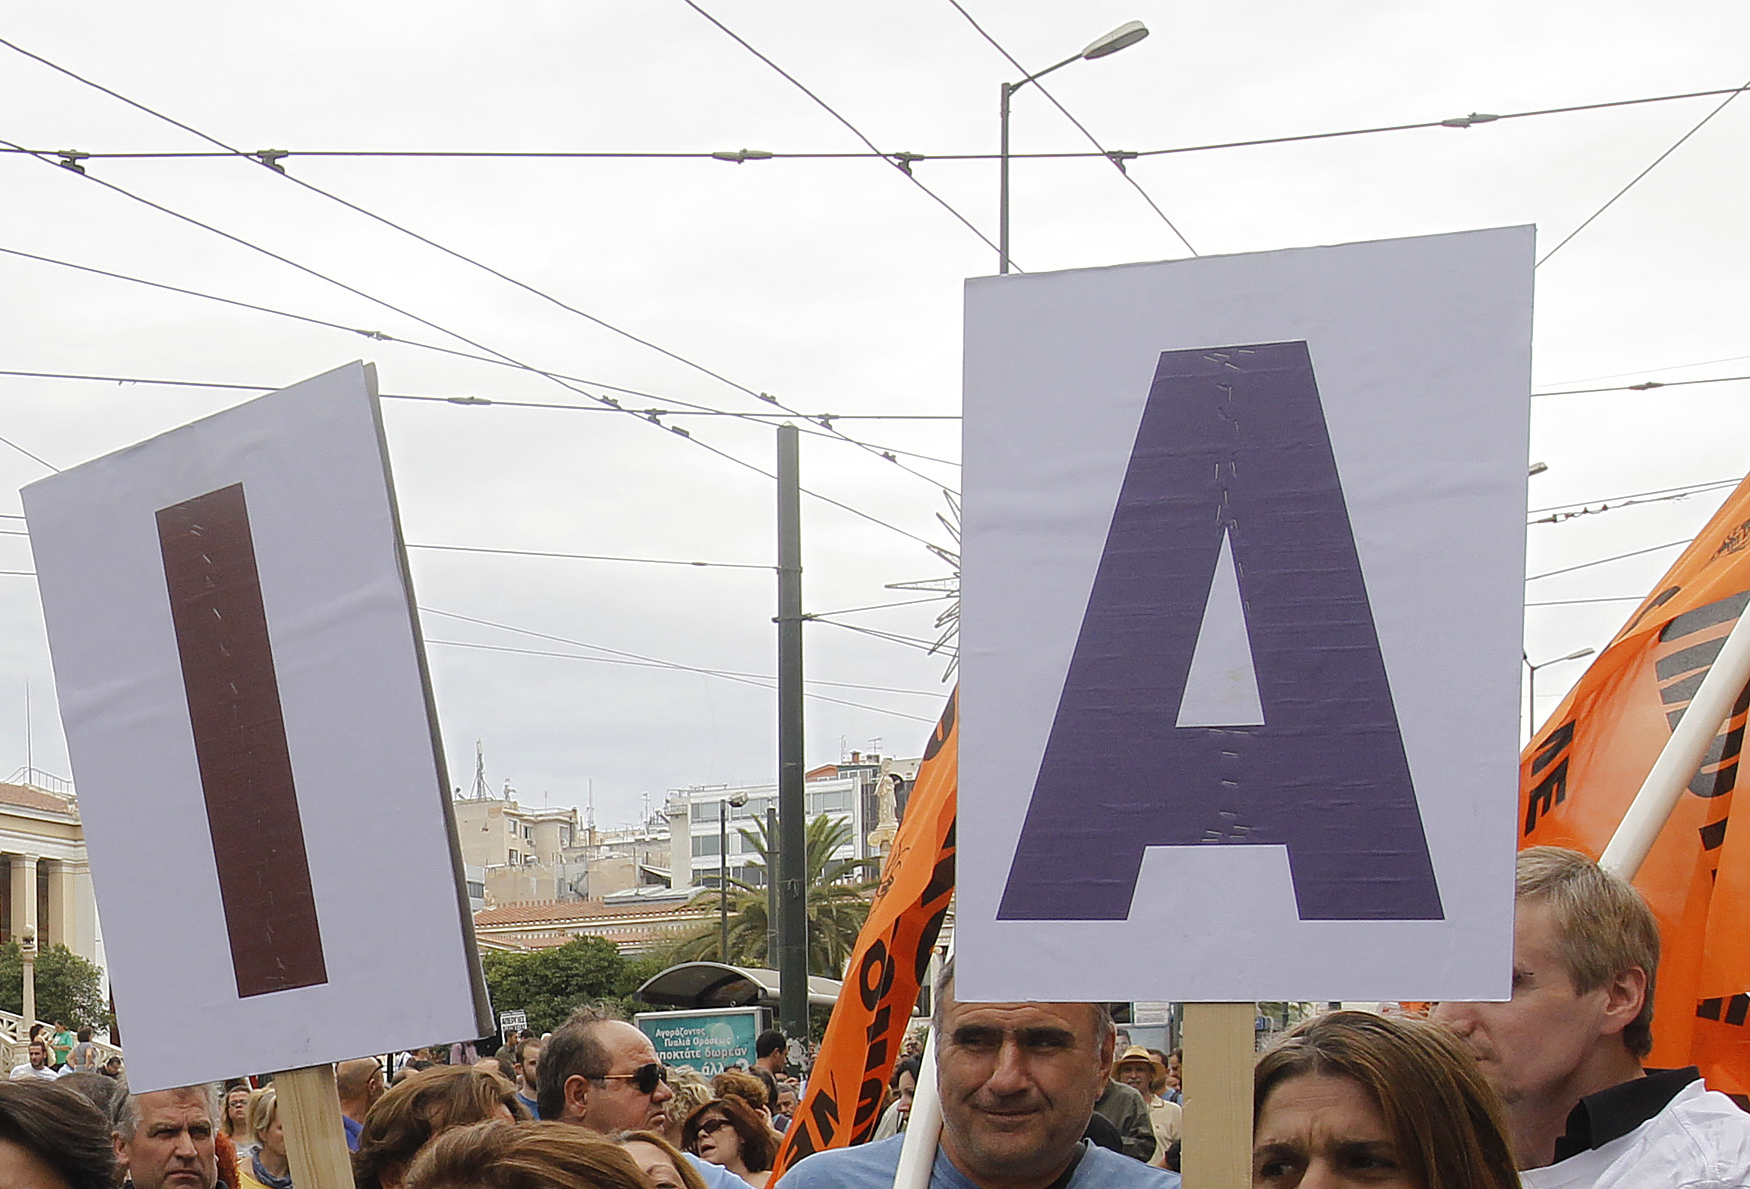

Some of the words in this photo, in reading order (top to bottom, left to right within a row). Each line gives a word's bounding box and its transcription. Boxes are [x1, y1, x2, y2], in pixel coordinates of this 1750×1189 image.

[655, 1027, 706, 1039] Αγοράζοντας
[664, 1037, 690, 1047] Γυαλιά
[704, 1046, 748, 1060] δωρεάν
